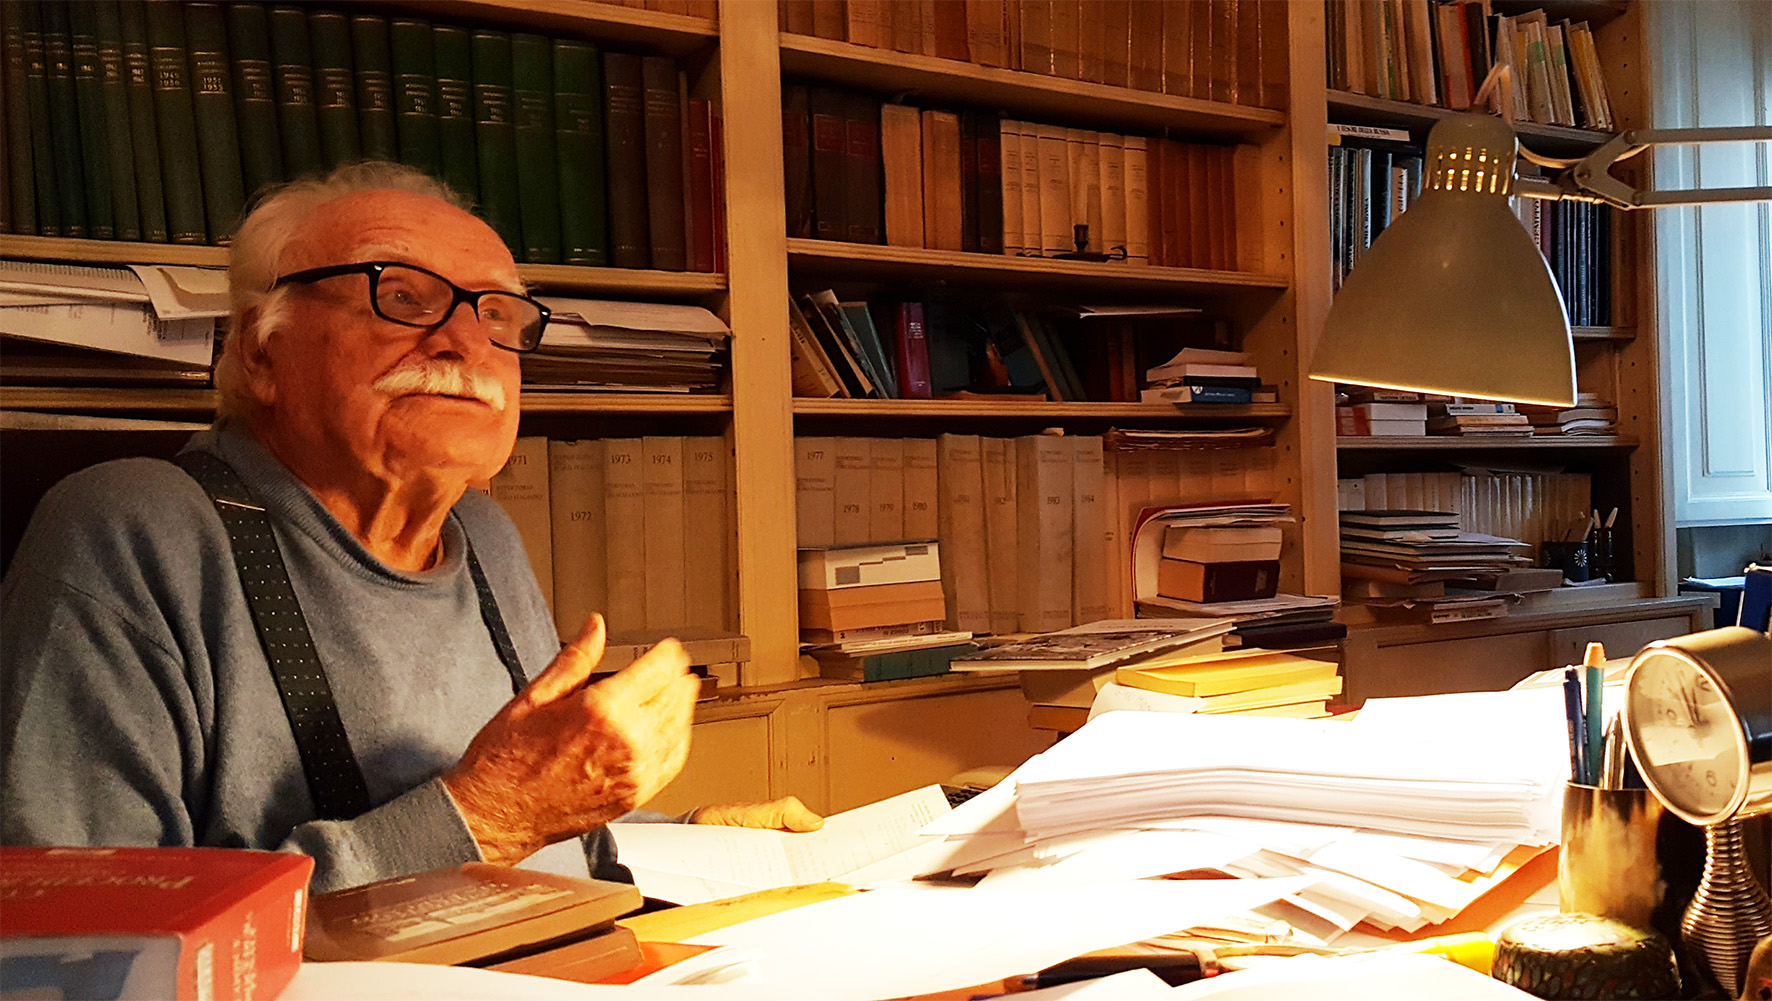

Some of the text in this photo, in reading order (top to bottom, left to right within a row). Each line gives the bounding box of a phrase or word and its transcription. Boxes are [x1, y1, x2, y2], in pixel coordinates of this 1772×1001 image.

[611, 454, 632, 465] 1973
[652, 454, 671, 465] 1974
[694, 452, 713, 462] 1975
[807, 451, 824, 460] 1977
[570, 511, 592, 521] 1972
